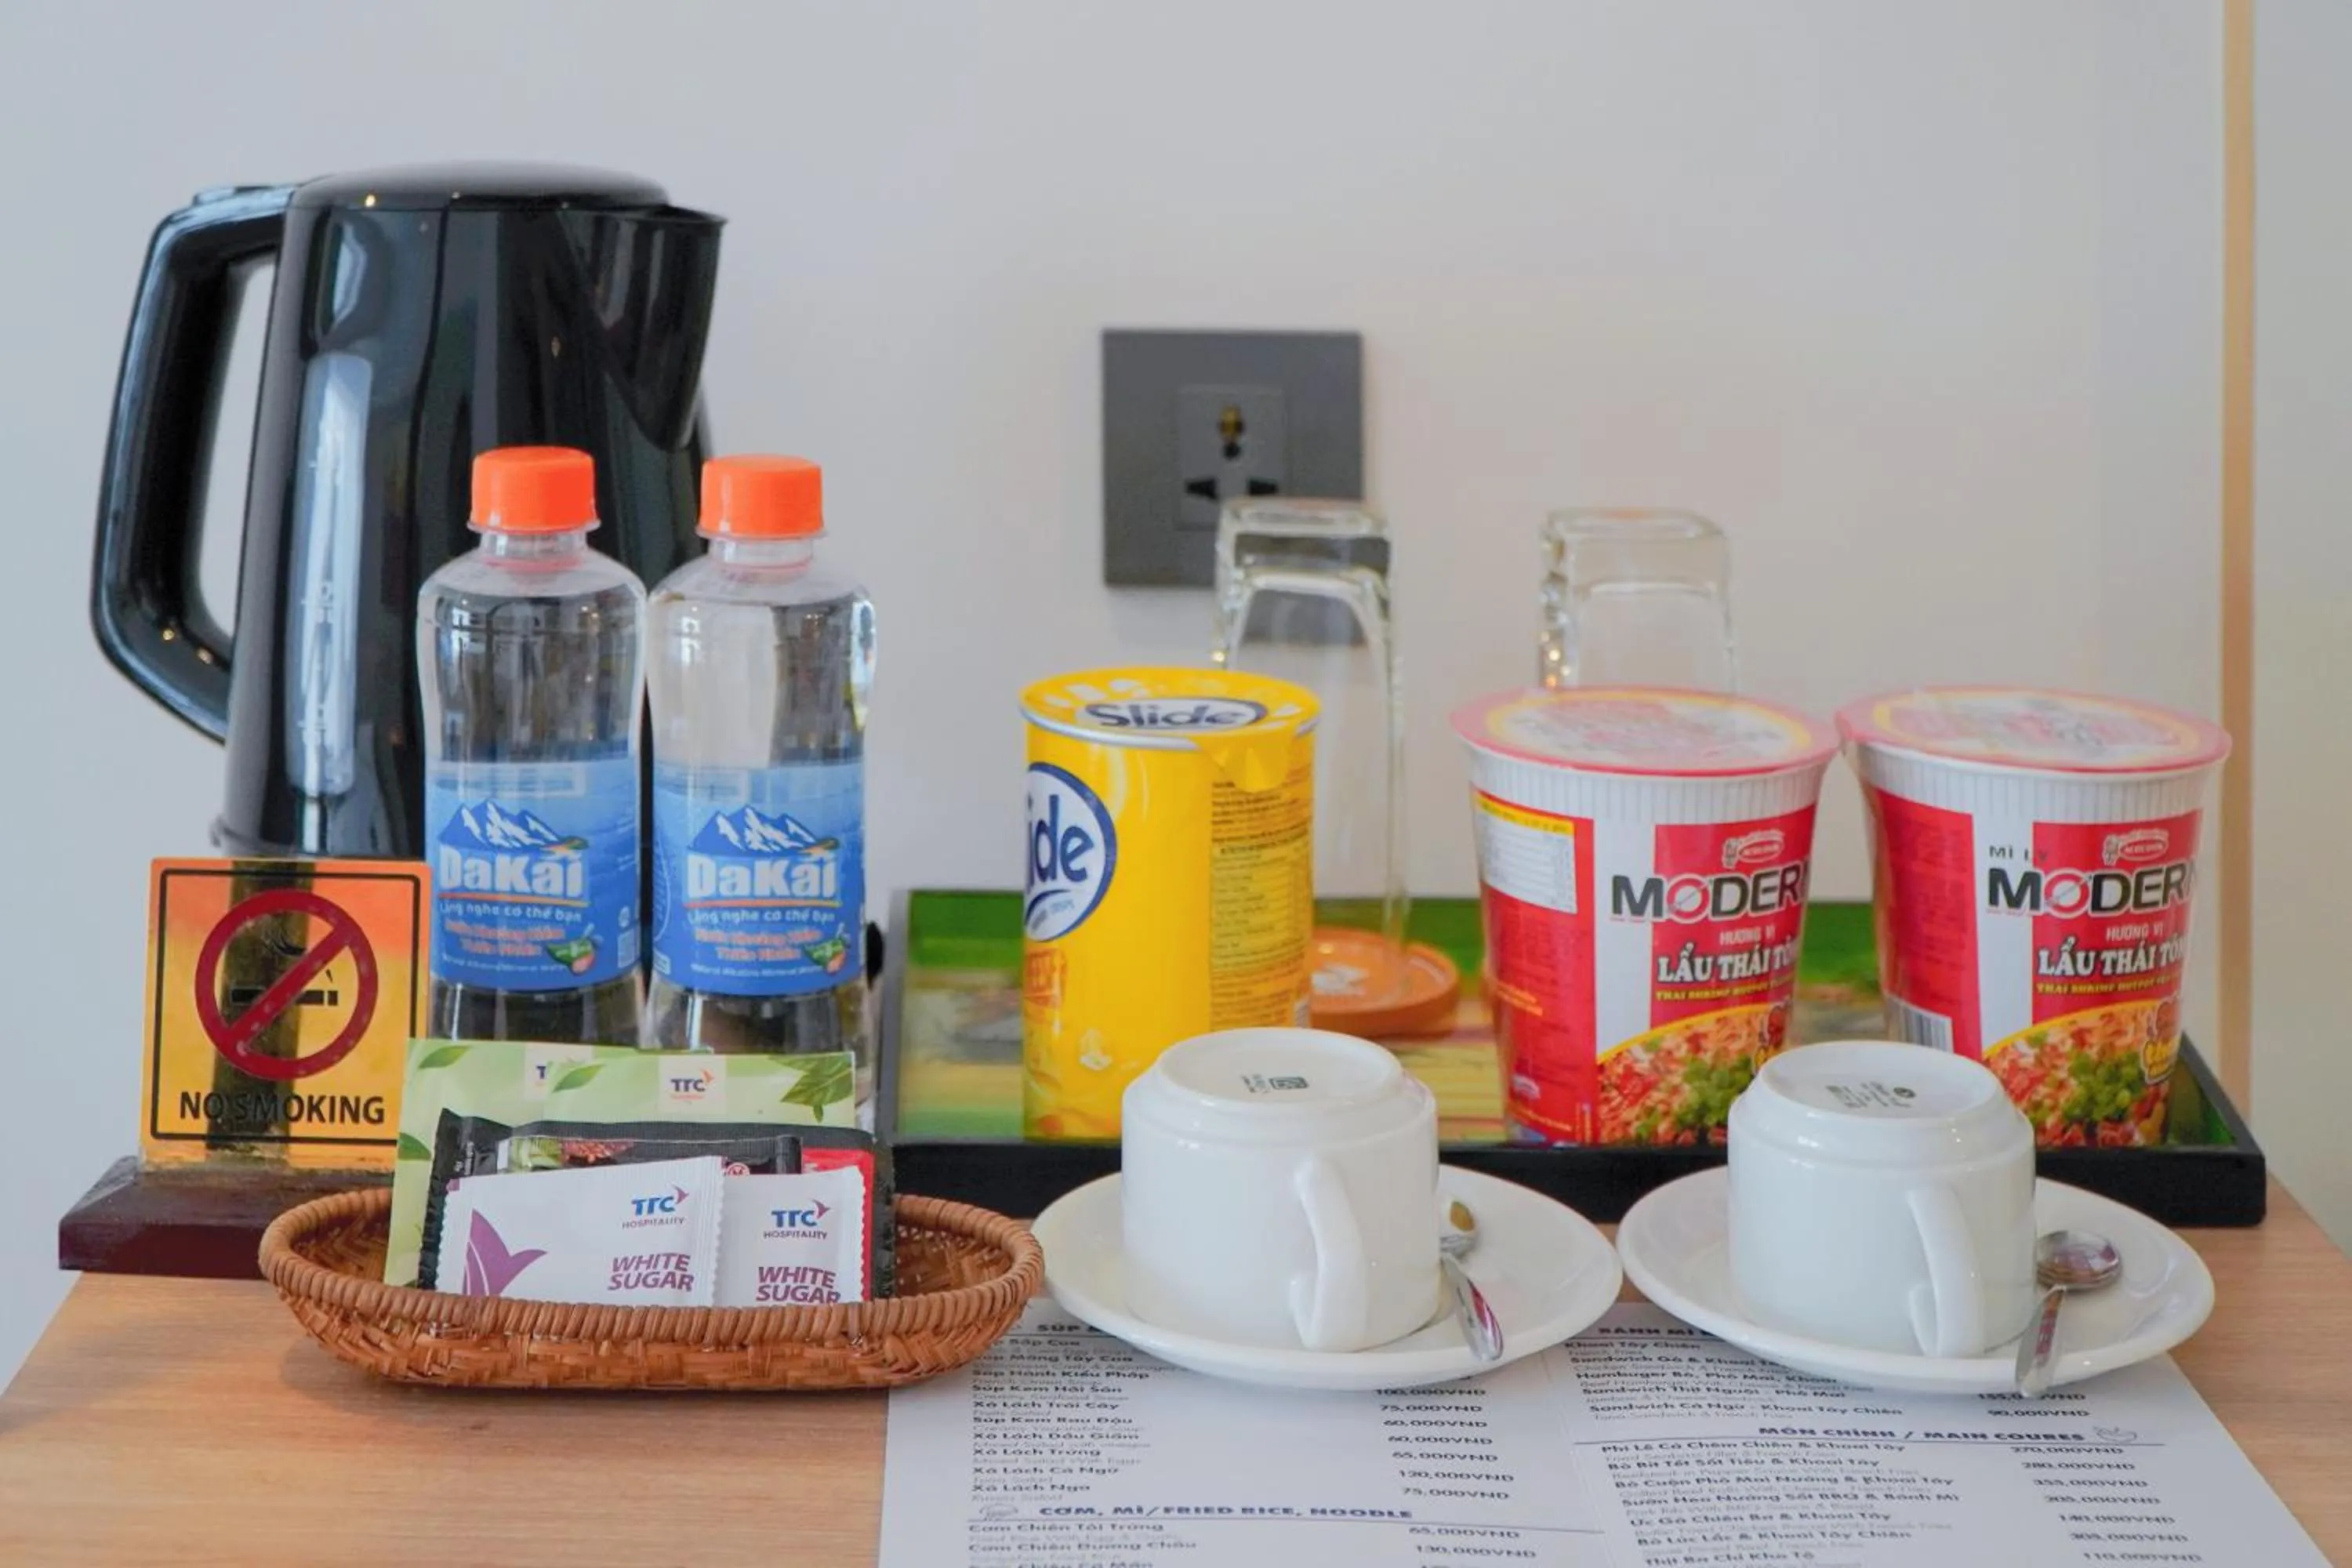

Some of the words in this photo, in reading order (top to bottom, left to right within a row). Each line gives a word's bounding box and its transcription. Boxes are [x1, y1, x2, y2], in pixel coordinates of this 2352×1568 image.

[1086, 703, 1247, 727] Slide
[1026, 793, 1094, 894] ide
[1612, 861, 1806, 918] MODER
[1717, 945, 1772, 980] THÁI
[2100, 940, 2157, 975] THÁI
[671, 1078, 706, 1092] TTC
[180, 1091, 223, 1120] NO
[230, 1092, 385, 1125] SMOKING
[631, 1195, 677, 1215] TTC
[622, 1217, 685, 1229] HOSPITALITY
[771, 1210, 818, 1228] TTC
[764, 1230, 828, 1240] HOSPITALITY
[612, 1253, 691, 1272] WHITE
[608, 1271, 694, 1292] SUGAR
[757, 1266, 837, 1288] WHITE
[756, 1284, 841, 1304] SUGAR
